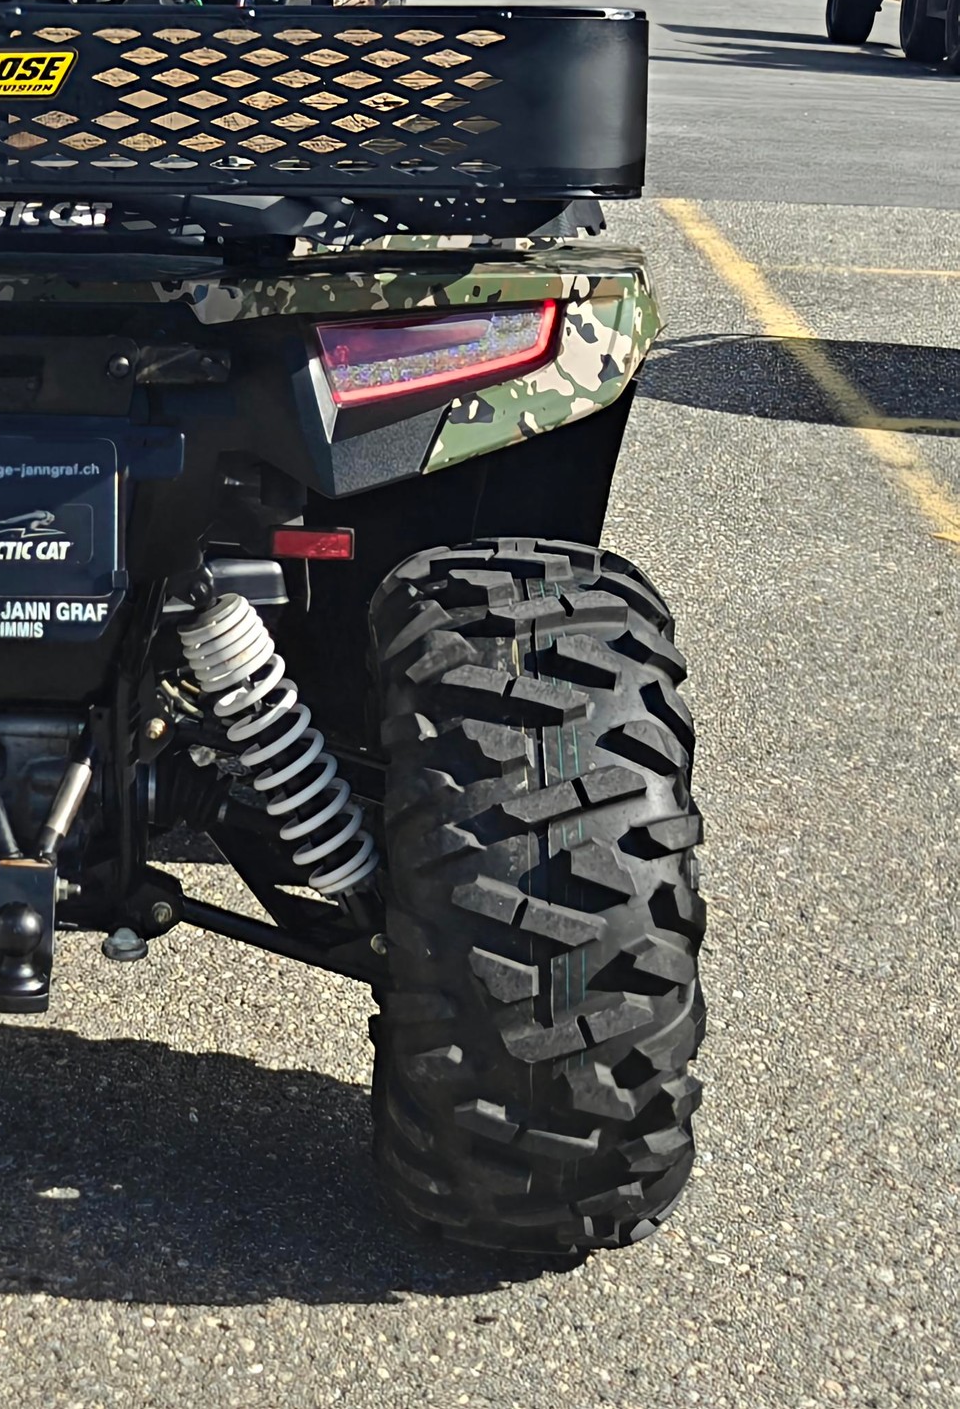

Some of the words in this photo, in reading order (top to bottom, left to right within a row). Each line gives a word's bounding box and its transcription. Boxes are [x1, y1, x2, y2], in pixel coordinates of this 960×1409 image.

[49, 201, 112, 227] CAT
[35, 541, 70, 560] CAT
[0, 601, 50, 621] JANN
[56, 602, 109, 622] GRAF
